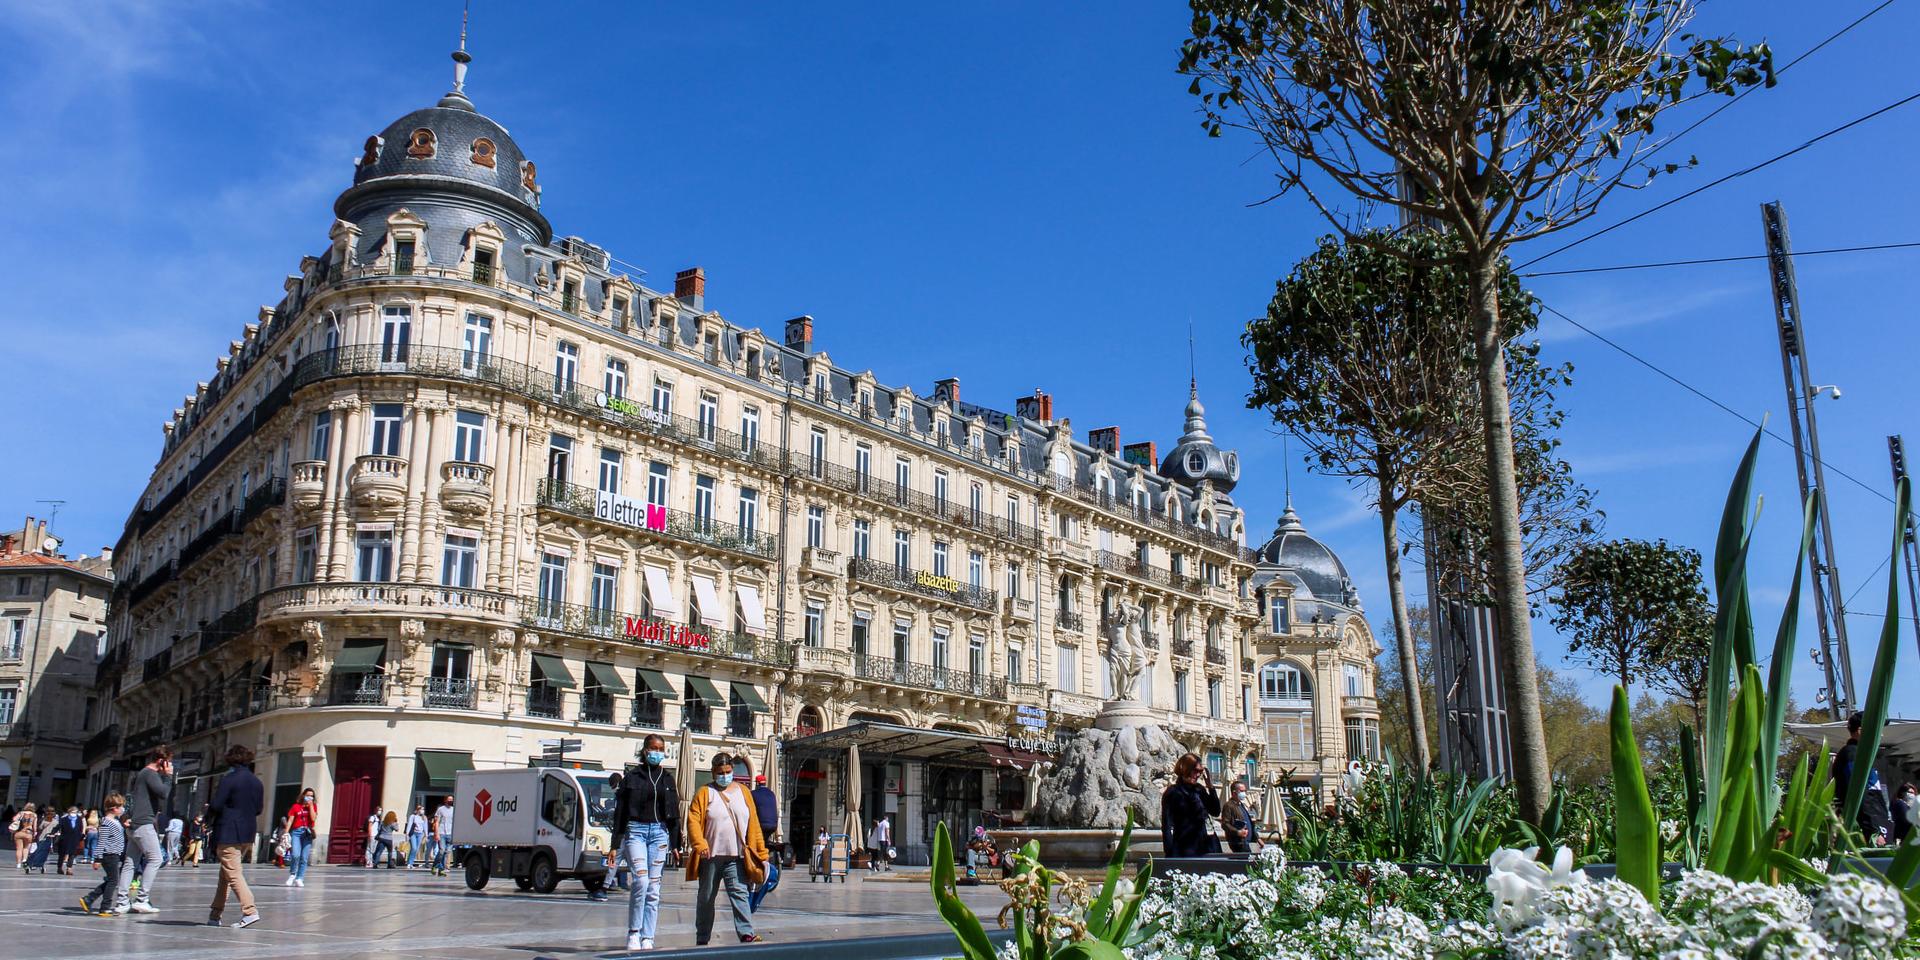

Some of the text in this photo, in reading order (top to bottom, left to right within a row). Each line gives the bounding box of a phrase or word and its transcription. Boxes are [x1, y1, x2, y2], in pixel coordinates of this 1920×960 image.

[607, 396, 639, 416] SENZO
[597, 491, 666, 532] la lettre M
[625, 617, 709, 649] Midi Libre
[496, 796, 517, 816] dpd
